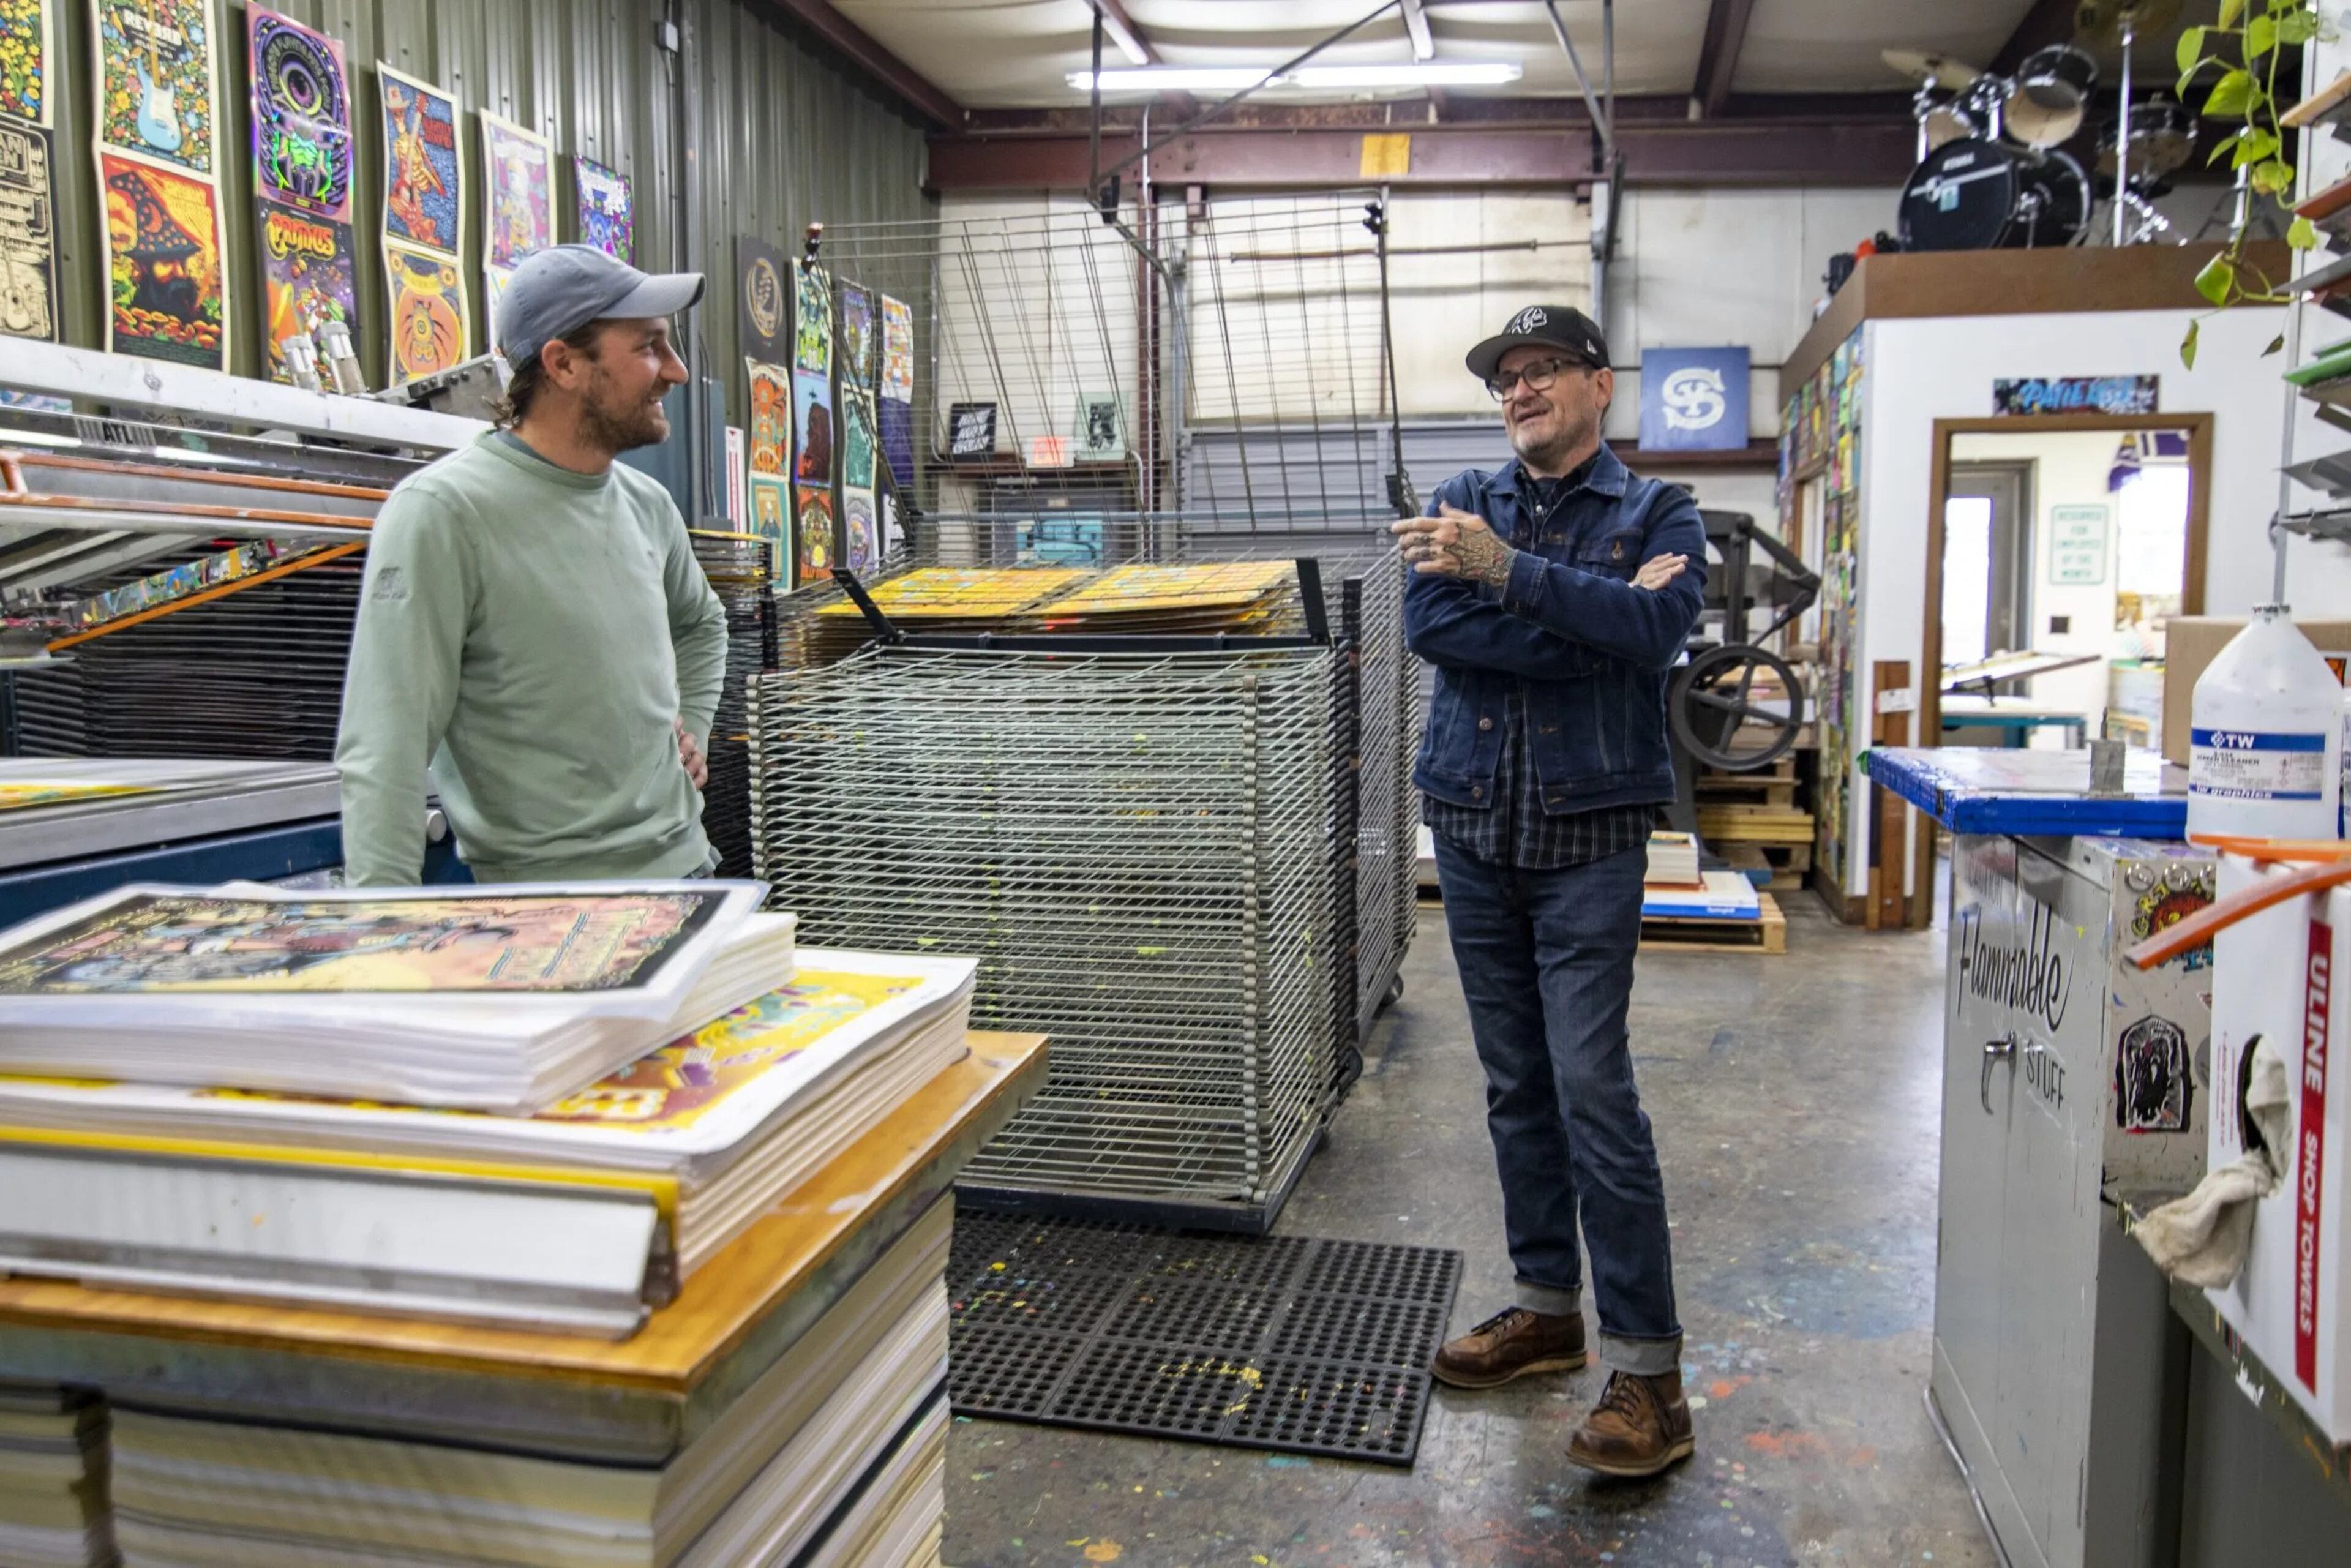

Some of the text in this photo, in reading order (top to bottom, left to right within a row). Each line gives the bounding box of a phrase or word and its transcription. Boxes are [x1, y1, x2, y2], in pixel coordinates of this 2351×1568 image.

[102, 422, 133, 445] ATL
[2225, 735, 2255, 748] TW
[1957, 900, 2075, 1031] Flammable
[2027, 1038, 2065, 1109] STUFF
[2299, 953, 2328, 1336] ULINE SHOP TOWELS
